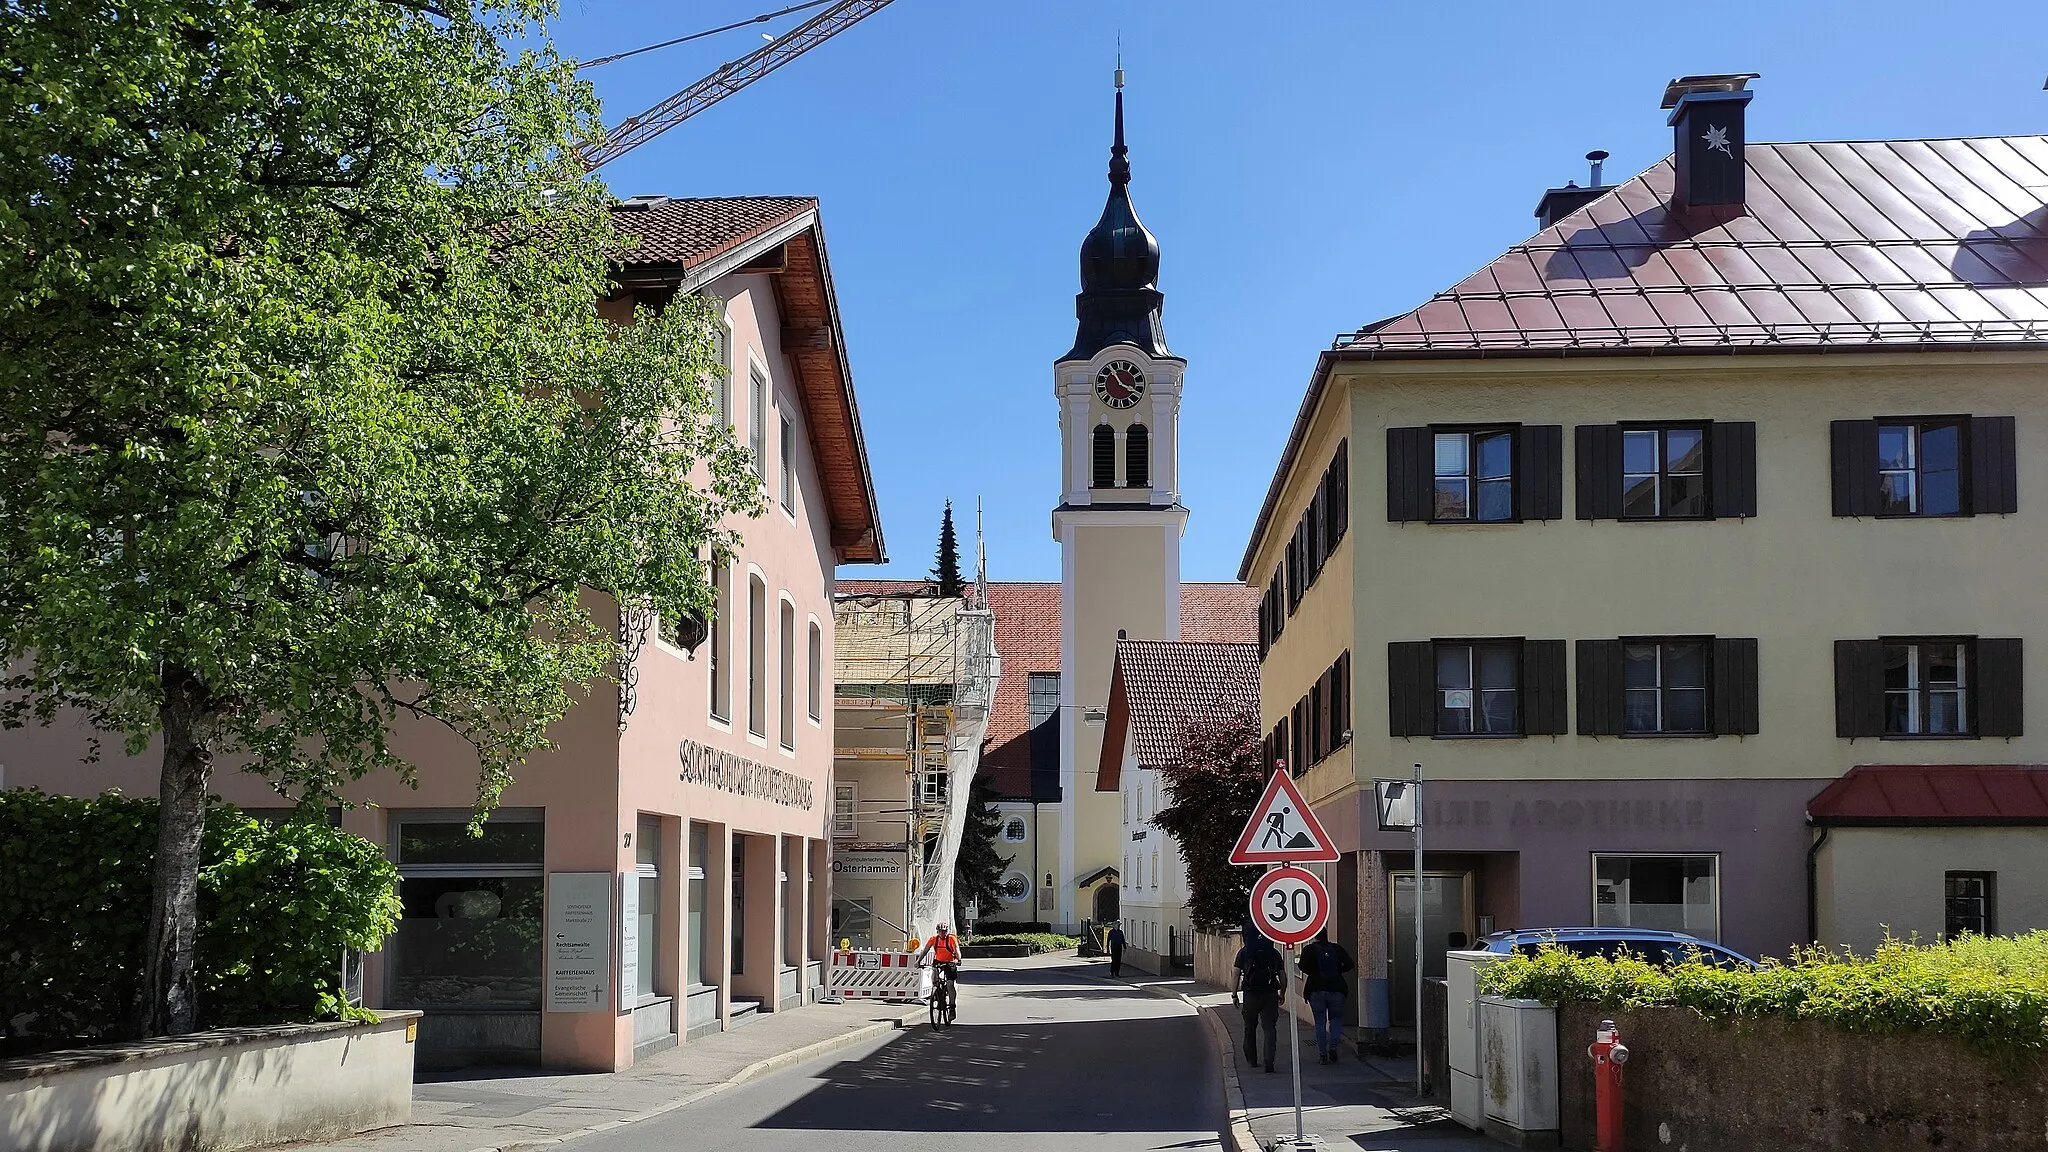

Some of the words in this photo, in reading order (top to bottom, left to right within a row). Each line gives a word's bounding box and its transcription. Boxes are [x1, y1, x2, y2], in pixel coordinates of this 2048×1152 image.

[1510, 799, 1705, 827] APOTHEKE
[832, 860, 901, 873] Osterhammer
[1268, 888, 1312, 923] 30
